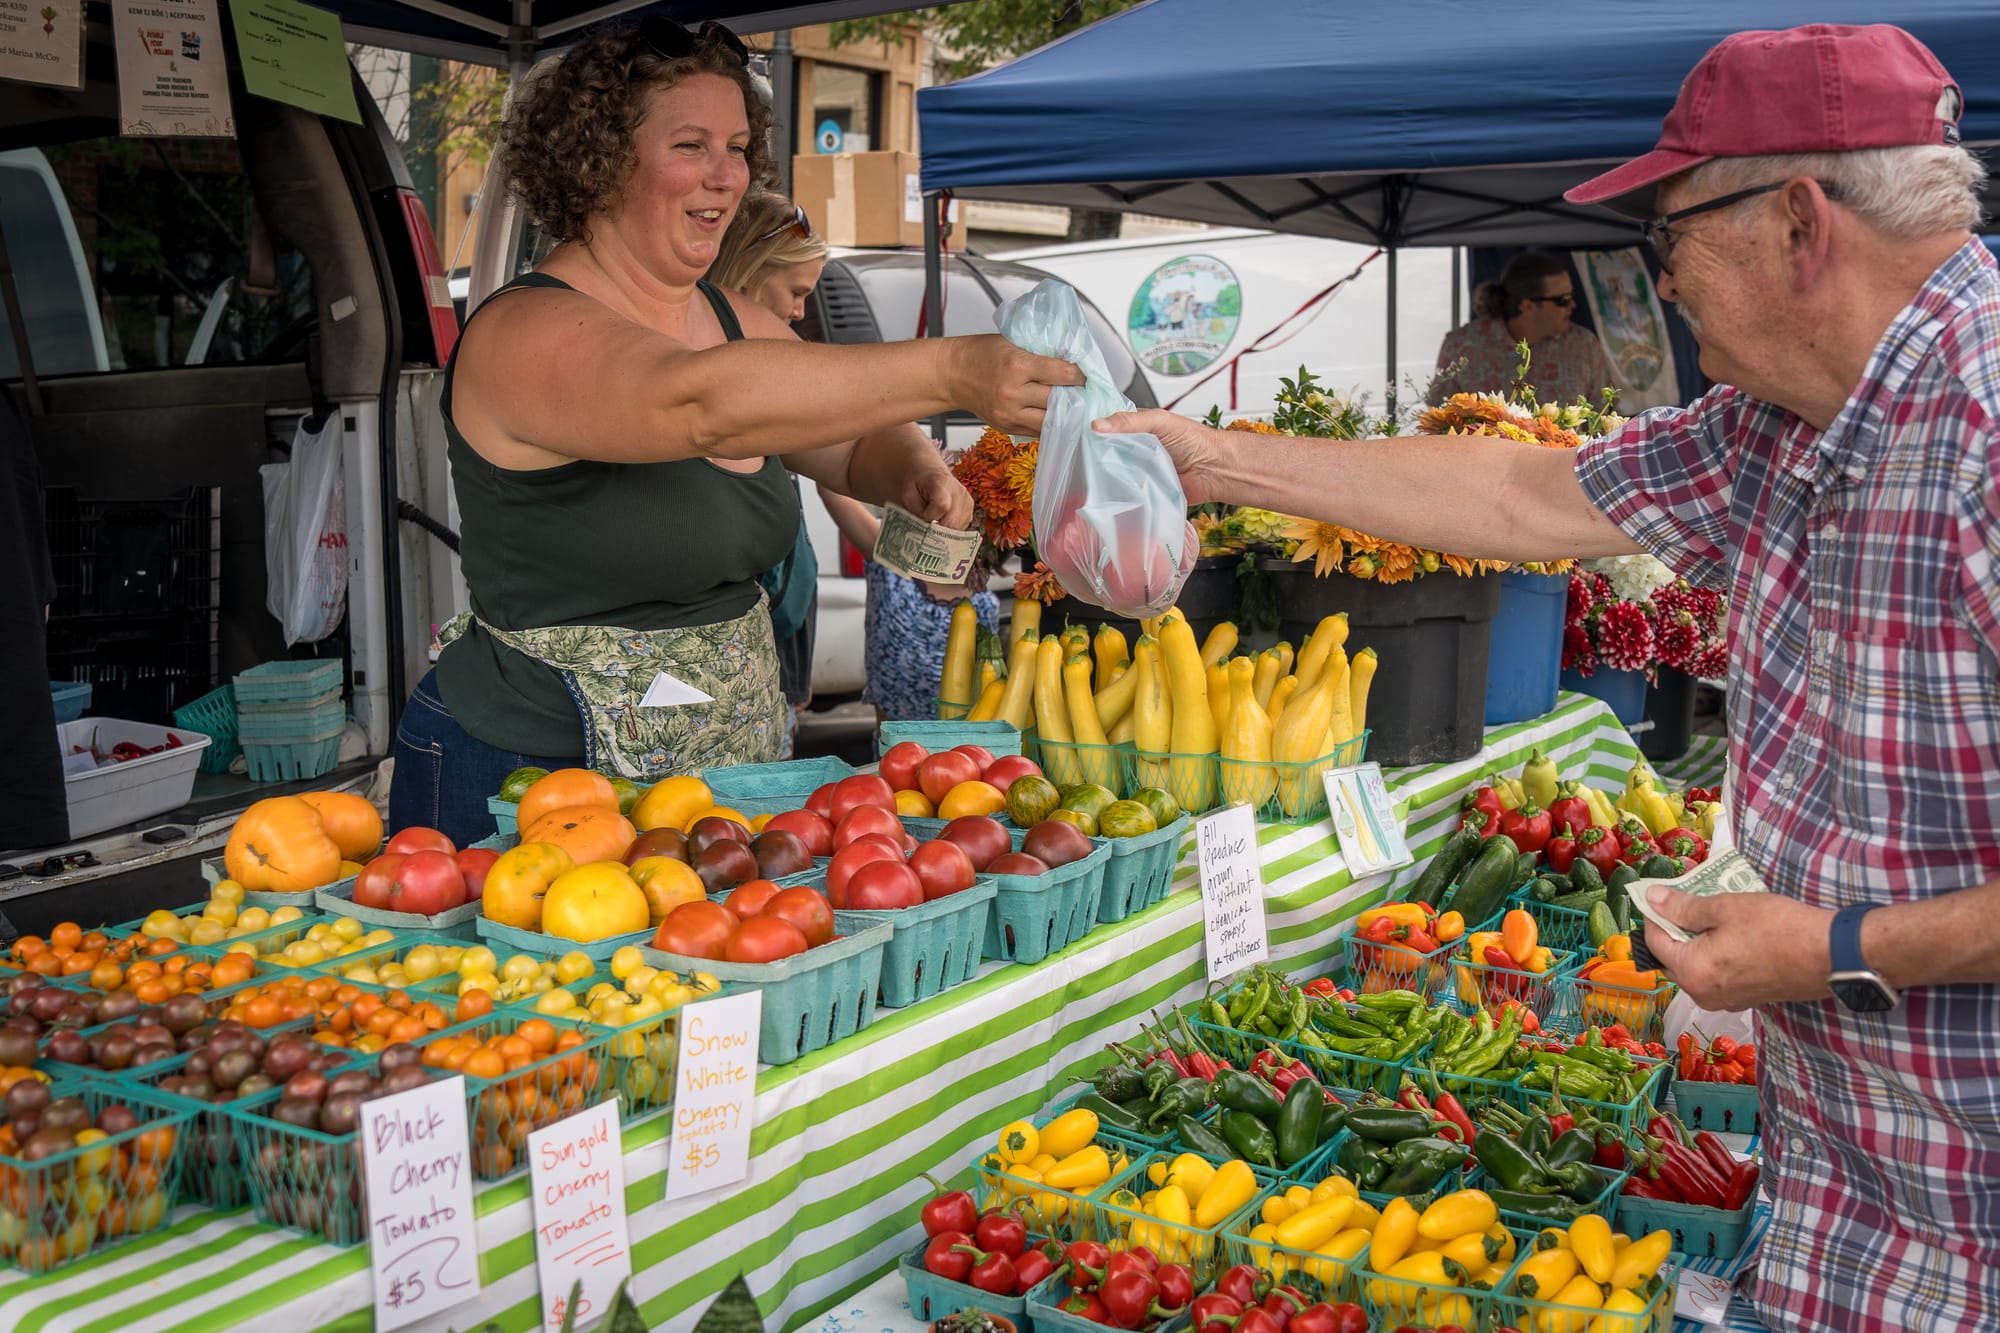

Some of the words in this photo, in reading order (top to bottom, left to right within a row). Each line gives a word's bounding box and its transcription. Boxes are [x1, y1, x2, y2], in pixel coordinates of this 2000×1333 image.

[169, 12, 206, 21] ACEPTAMOS
[9, 48, 33, 58] Marina
[35, 52, 60, 63] McCoy
[951, 559, 971, 580] 5
[1203, 821, 1217, 847] All
[1207, 865, 1234, 901] grown
[687, 1016, 748, 1057] Snow
[685, 1059, 748, 1092] White
[373, 1103, 446, 1155] Black
[389, 1151, 462, 1195] Cherry
[681, 1142, 721, 1178] $5
[544, 1168, 611, 1206] Cherry
[375, 1194, 457, 1247] Tomato
[539, 1200, 612, 1246] Tomato
[384, 1270, 426, 1309] $5
